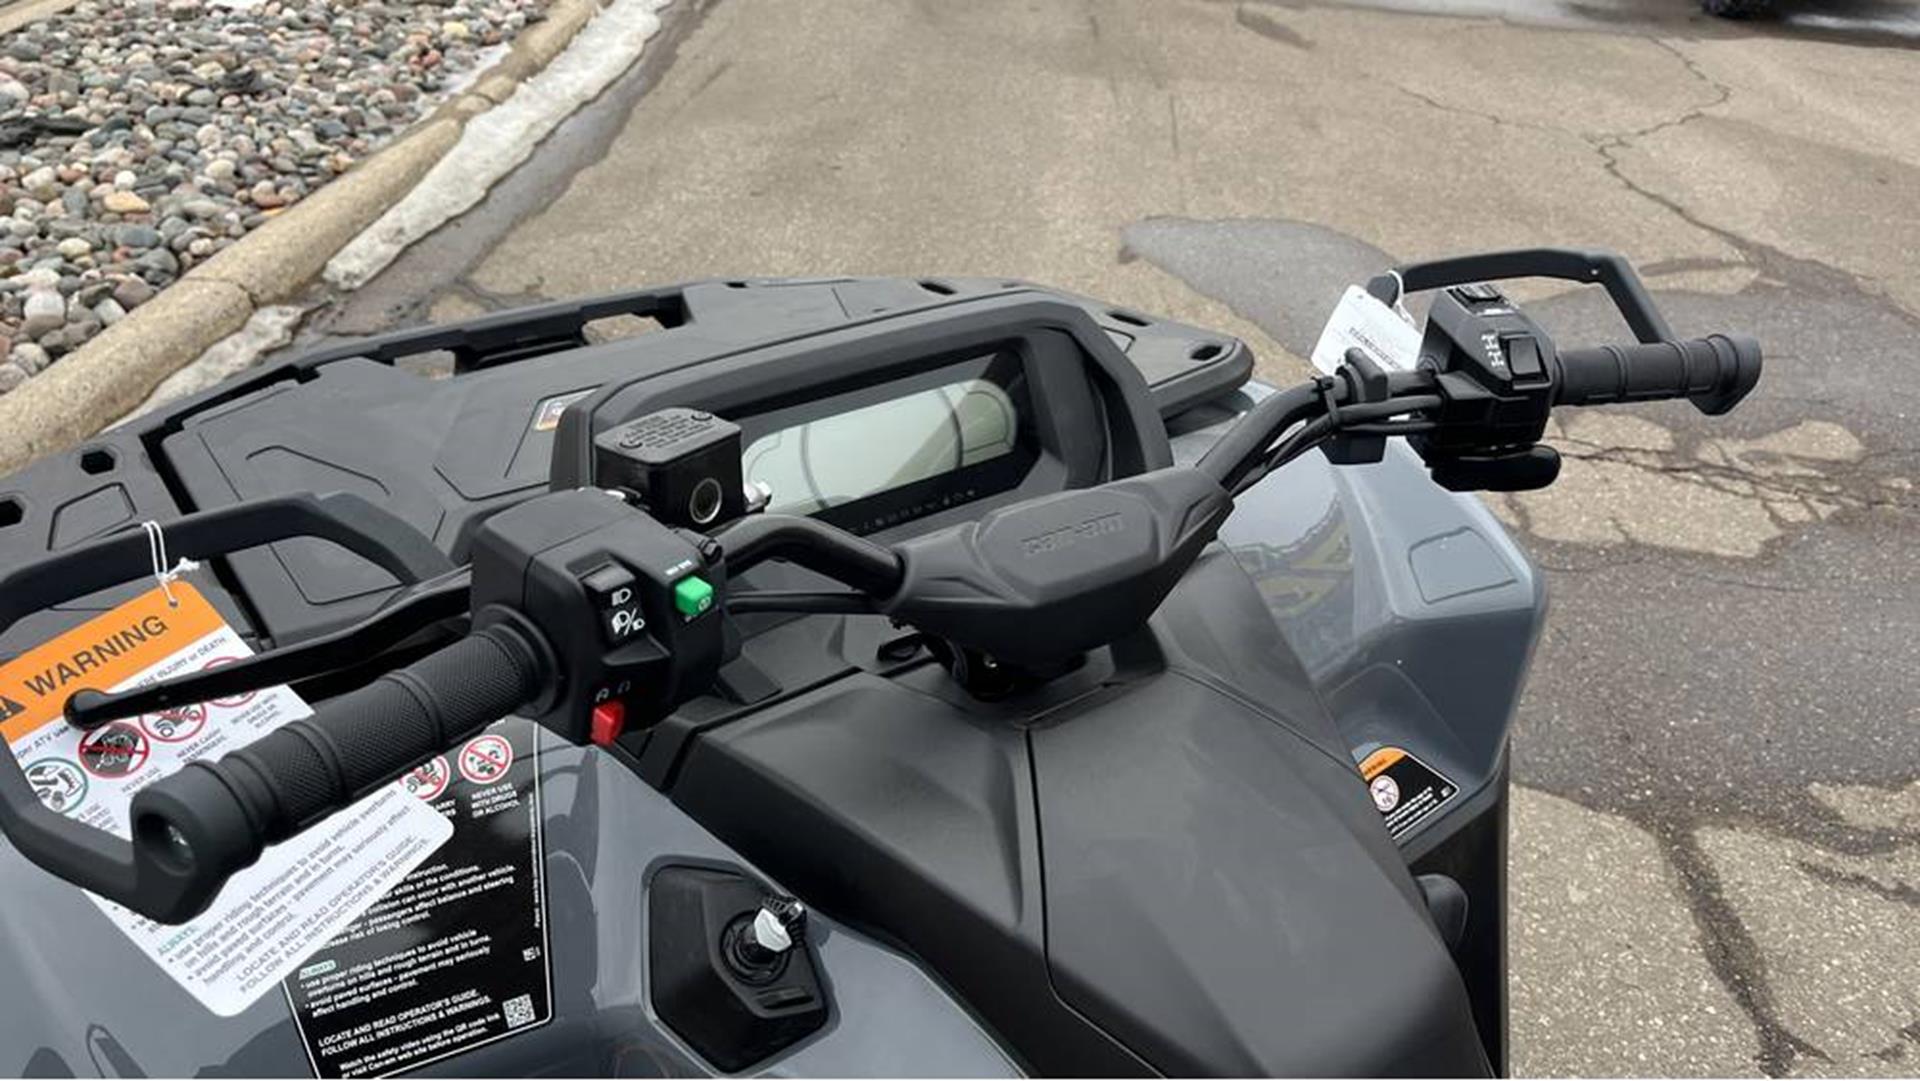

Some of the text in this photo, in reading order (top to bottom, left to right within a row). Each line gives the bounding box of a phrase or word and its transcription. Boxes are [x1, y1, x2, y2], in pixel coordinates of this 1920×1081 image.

[23, 615, 169, 697] WARNING
[32, 734, 52, 748] ATV
[305, 979, 320, 989] use
[321, 971, 348, 985] proper
[347, 961, 373, 976] riding
[372, 947, 416, 968] techniques
[416, 944, 426, 953] to
[426, 937, 448, 950] avoid
[448, 928, 477, 943] vehicle
[311, 1004, 334, 1017] affect
[334, 993, 371, 1011] handling
[370, 988, 386, 999] and
[317, 1028, 352, 1047] LOCATE
[351, 1022, 371, 1036] AND
[371, 1014, 396, 1029] READ
[320, 1037, 358, 1057] FOLLOW
[357, 1032, 374, 1045] ALL
[375, 1012, 436, 1039] INSTRUCTIONS
[339, 1057, 363, 1070] Watch
[363, 1052, 376, 1063] the
[375, 1045, 399, 1060] safety
[399, 1038, 420, 1051] video
[420, 1031, 442, 1045] using
[441, 1027, 454, 1037] the
[454, 1022, 467, 1032] QR
[467, 1016, 485, 1028] code
